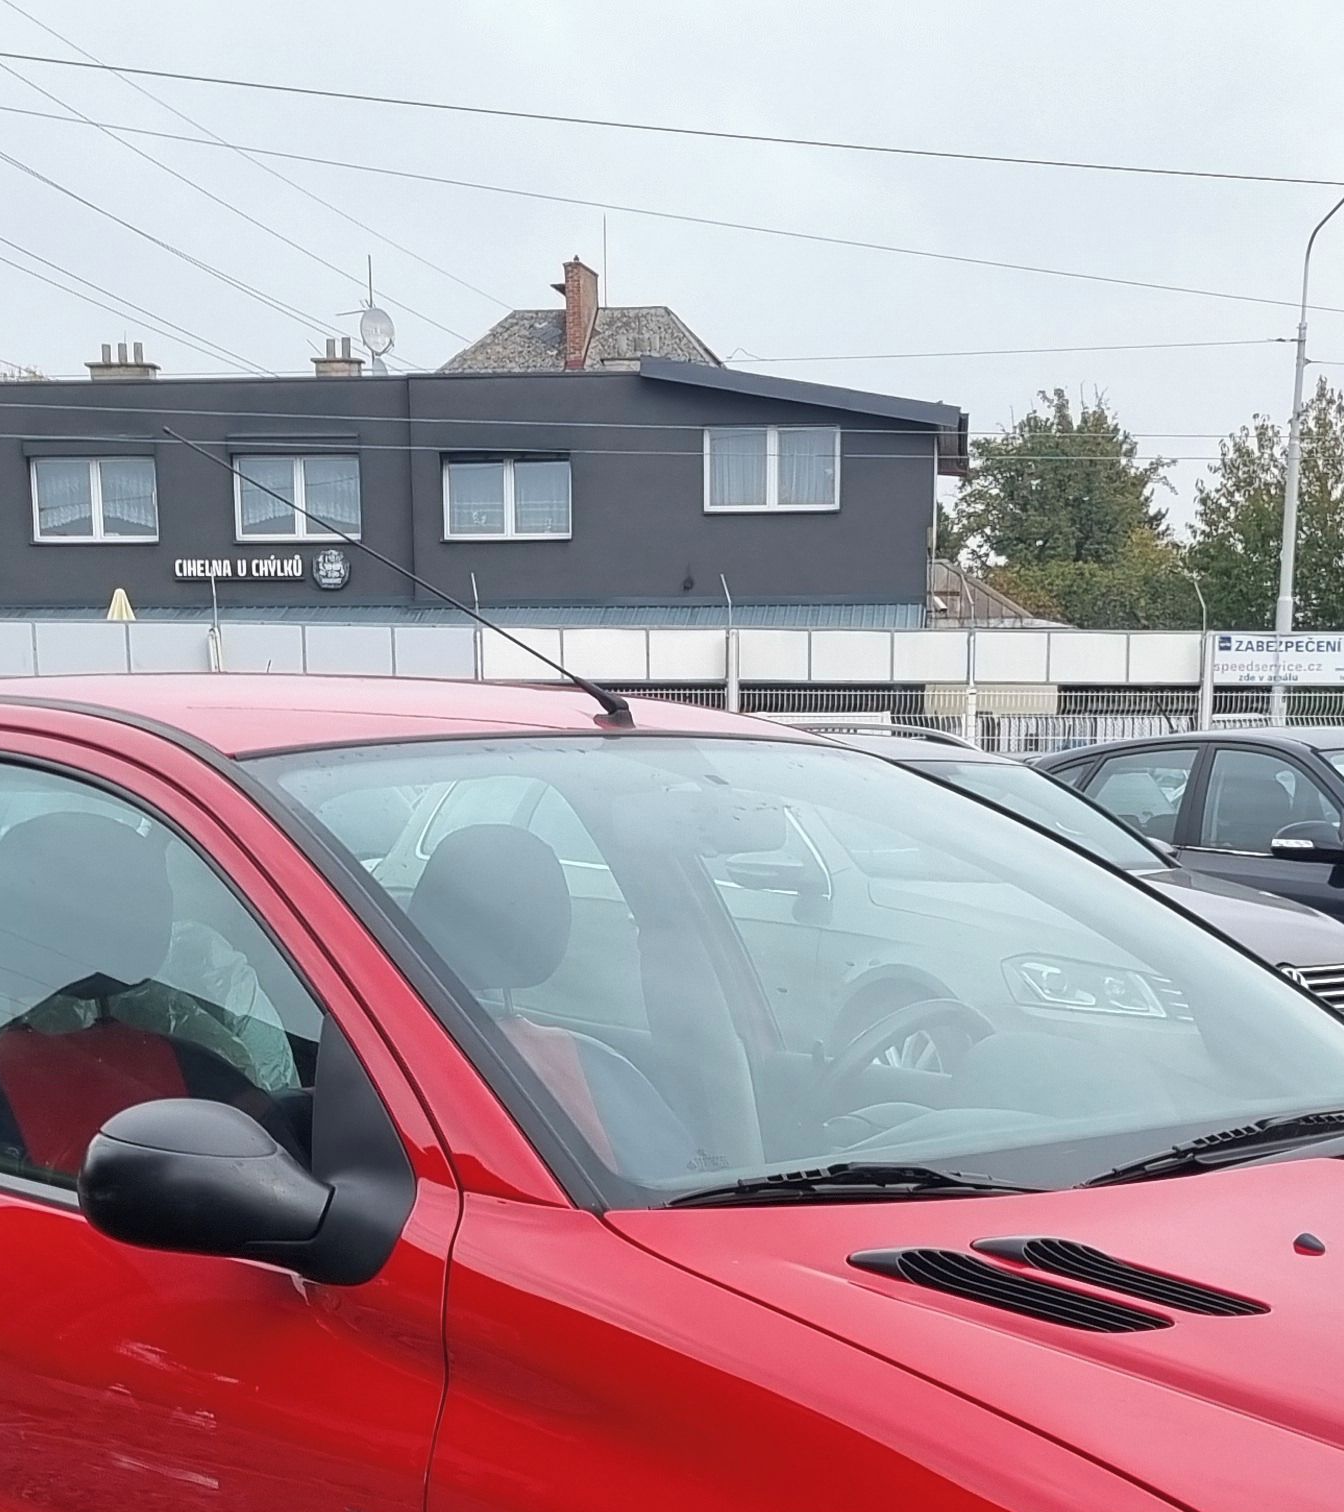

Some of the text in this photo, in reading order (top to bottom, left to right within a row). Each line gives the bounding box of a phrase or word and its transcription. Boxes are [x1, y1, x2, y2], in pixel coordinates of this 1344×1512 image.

[174, 554, 303, 577] CIHELNA U CHÝLKŮ
[1234, 637, 1343, 653] ZABEZPEČENÍ
